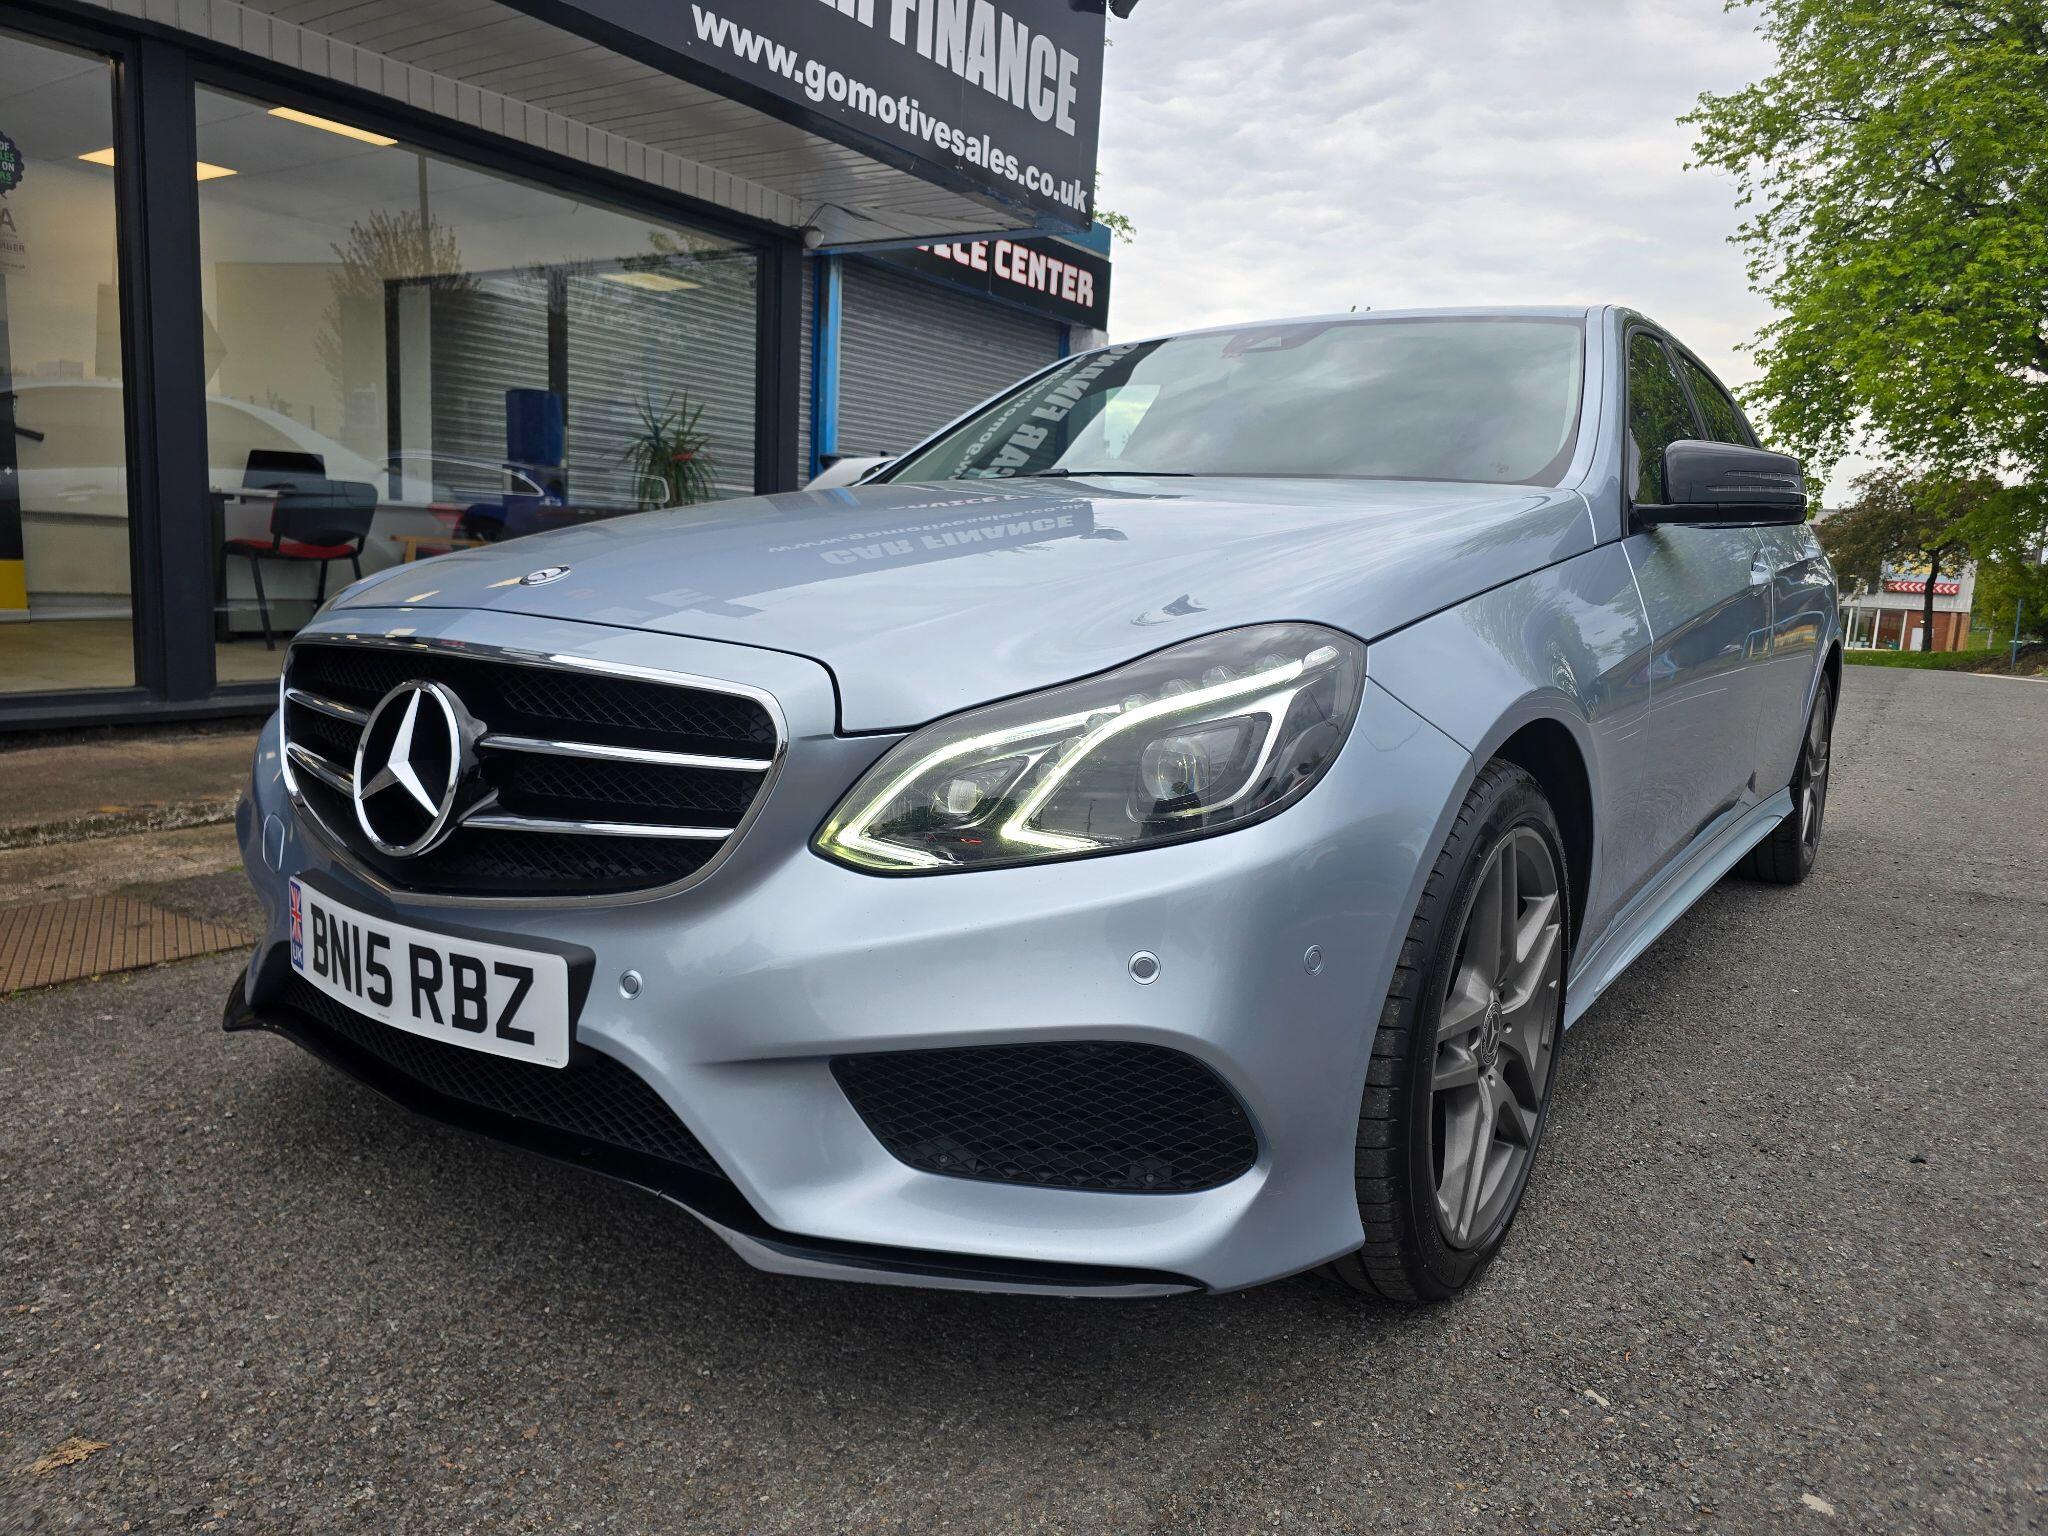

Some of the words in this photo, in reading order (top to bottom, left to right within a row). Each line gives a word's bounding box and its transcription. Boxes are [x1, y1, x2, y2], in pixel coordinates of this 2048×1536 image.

[692, 4, 1088, 214] www.gomotivesales.co.uk
[889, 0, 1079, 137] FINANCE
[994, 240, 1094, 308] CENTER
[311, 902, 393, 1008] BN15
[408, 942, 535, 1046] RBZ
